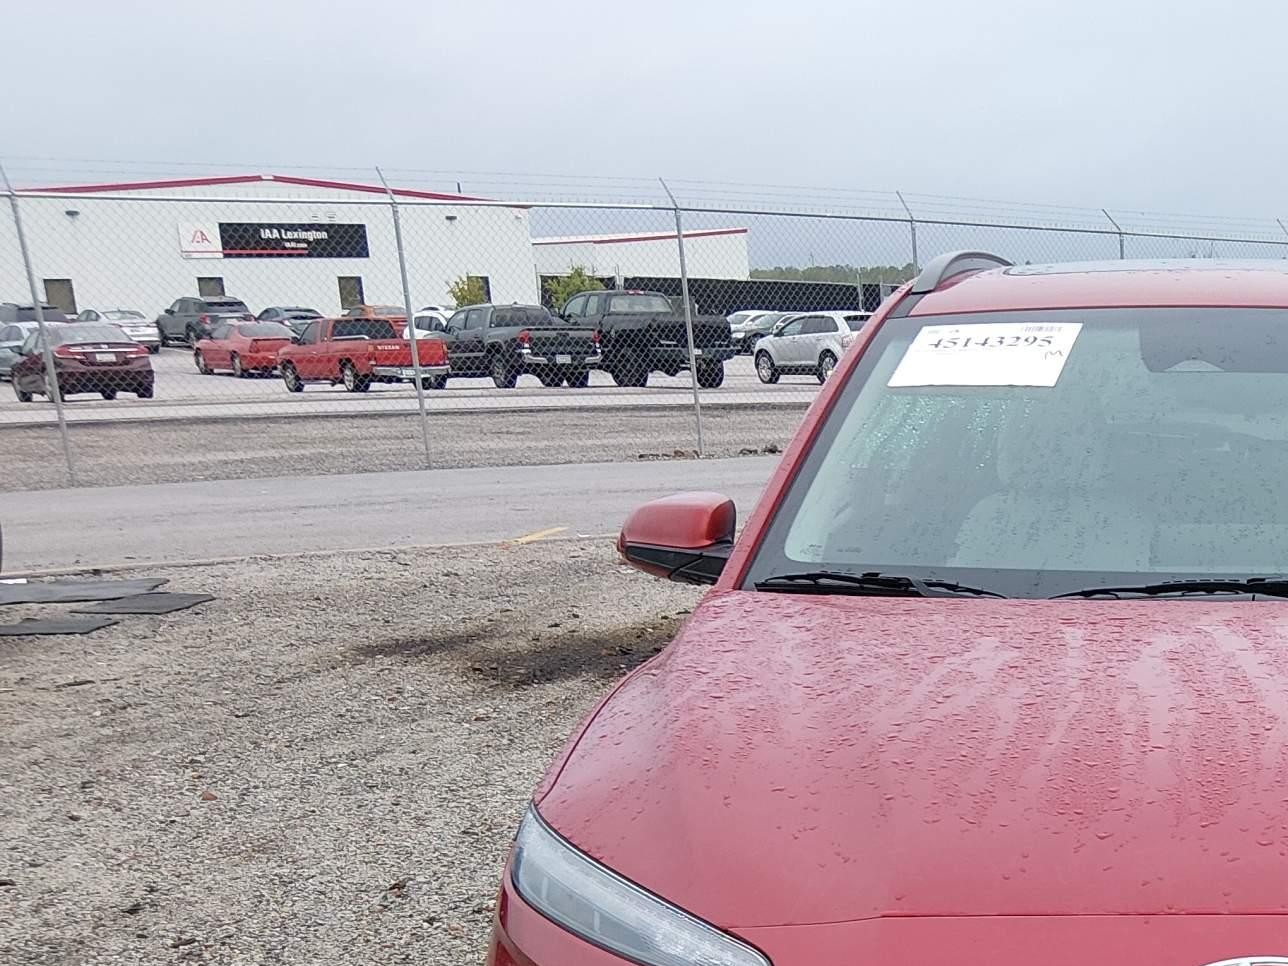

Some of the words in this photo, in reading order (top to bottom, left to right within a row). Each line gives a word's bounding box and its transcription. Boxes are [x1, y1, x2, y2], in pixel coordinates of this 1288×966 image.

[260, 228, 280, 239] IAA
[281, 228, 328, 241] Lexington
[928, 335, 1055, 349] 45143295
